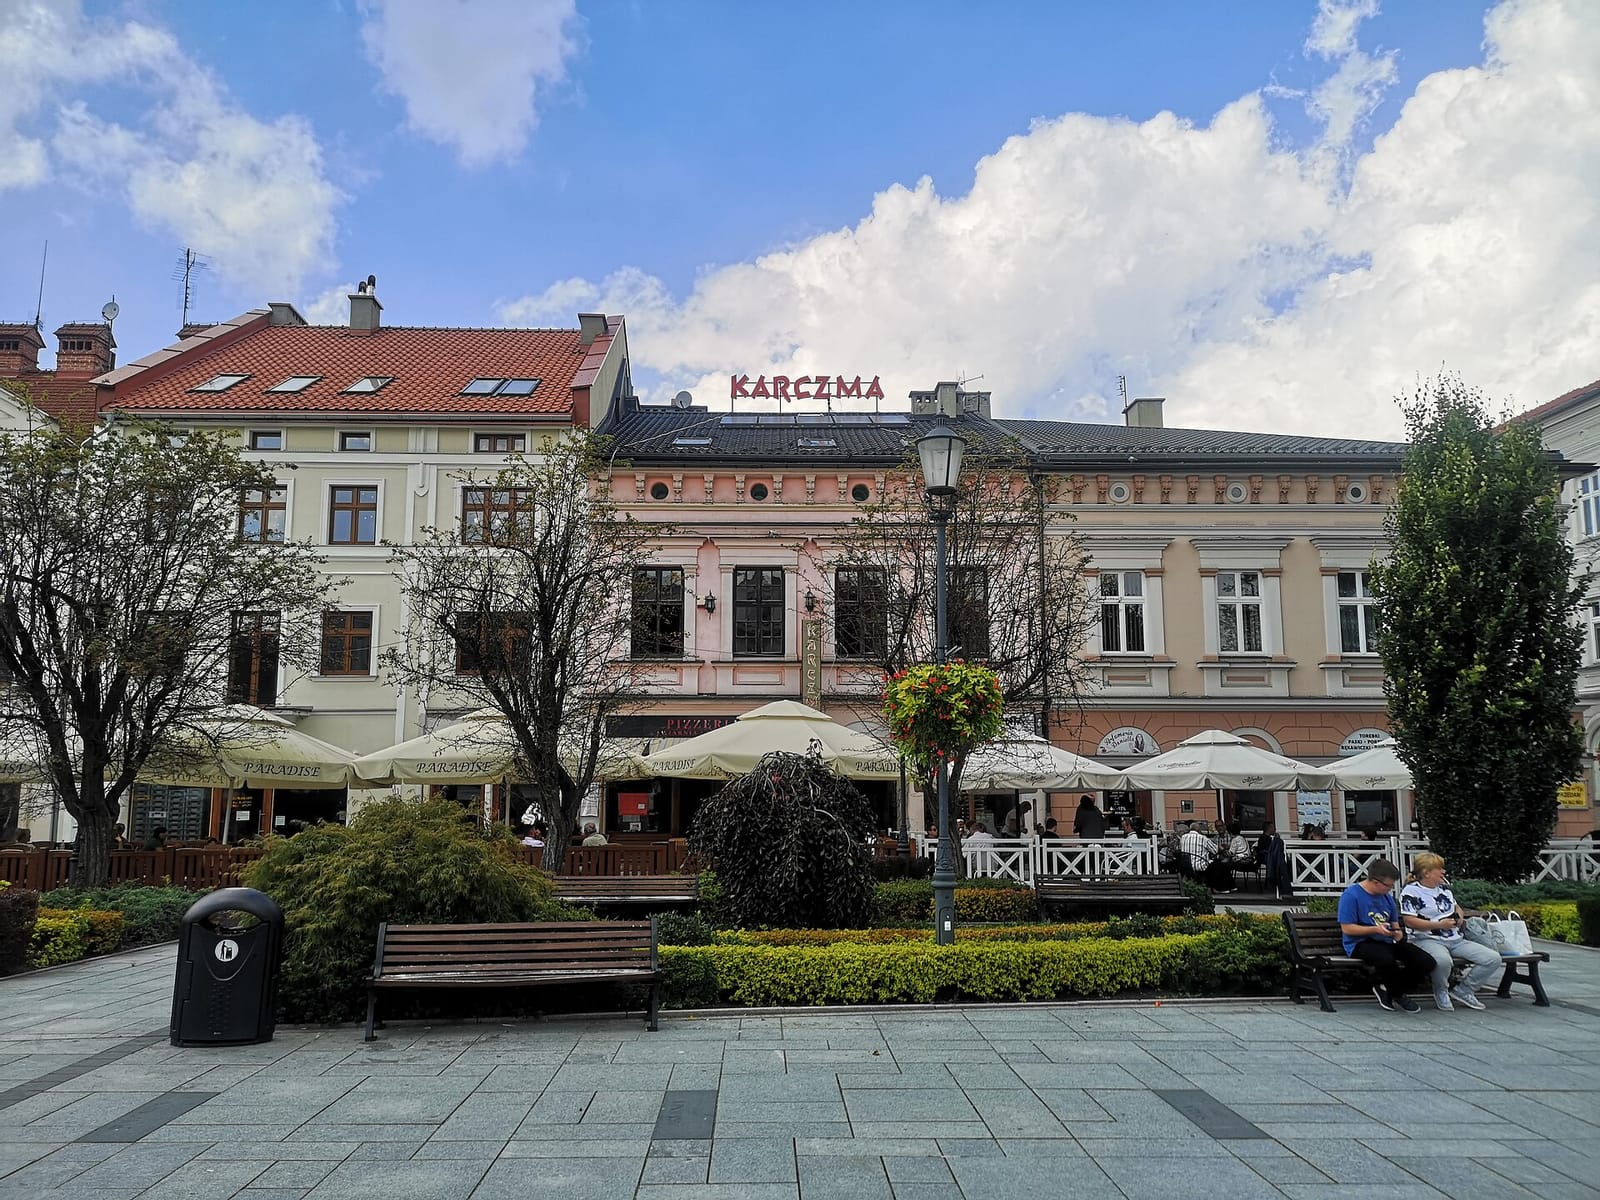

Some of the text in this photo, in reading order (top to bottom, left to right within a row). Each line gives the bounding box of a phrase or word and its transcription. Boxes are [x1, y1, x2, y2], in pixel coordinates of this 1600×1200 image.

[731, 374, 885, 403] KARCZMA
[243, 762, 321, 777] PARADISE
[416, 761, 491, 773] PARADISE
[651, 759, 696, 772] PARADISE
